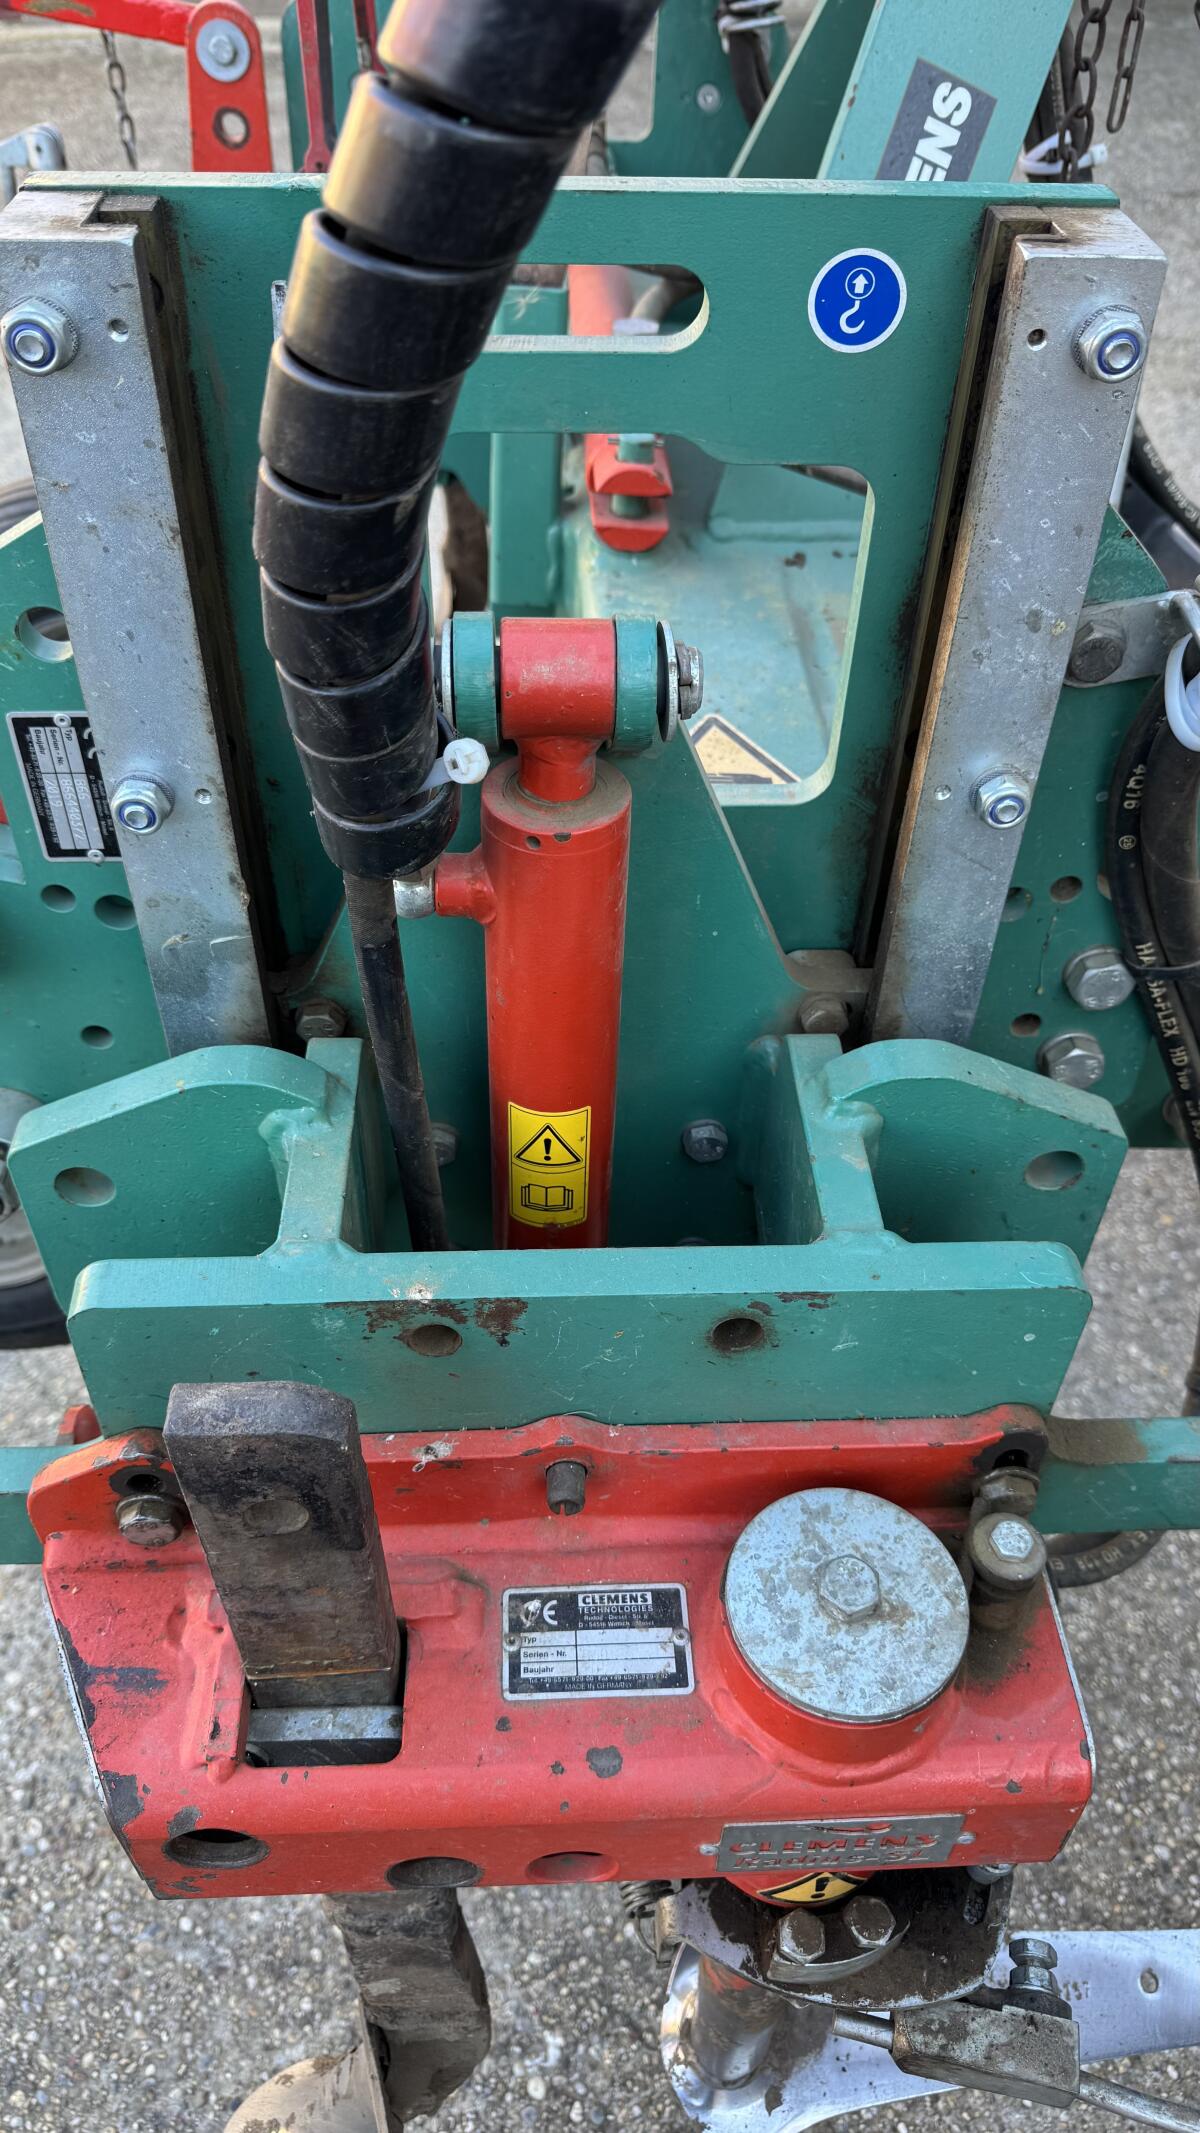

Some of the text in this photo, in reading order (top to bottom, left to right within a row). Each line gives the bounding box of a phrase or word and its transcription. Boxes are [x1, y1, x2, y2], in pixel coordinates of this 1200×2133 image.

[50, 729, 60, 751] Serien
[34, 729, 45, 755] Baujahr
[45, 779, 63, 807] 2019
[64, 730, 90, 801] Typ 866
[1123, 764, 1146, 810] 4Q16
[1136, 942, 1180, 1038] HASA-FLEX
[1169, 1046, 1188, 1066] HD
[578, 1605, 654, 1614] TECHNOLOGIES
[582, 1594, 648, 1605] CLEMENS
[523, 1666, 554, 1675] Baujahr
[730, 1834, 940, 1854] CLEMENS
